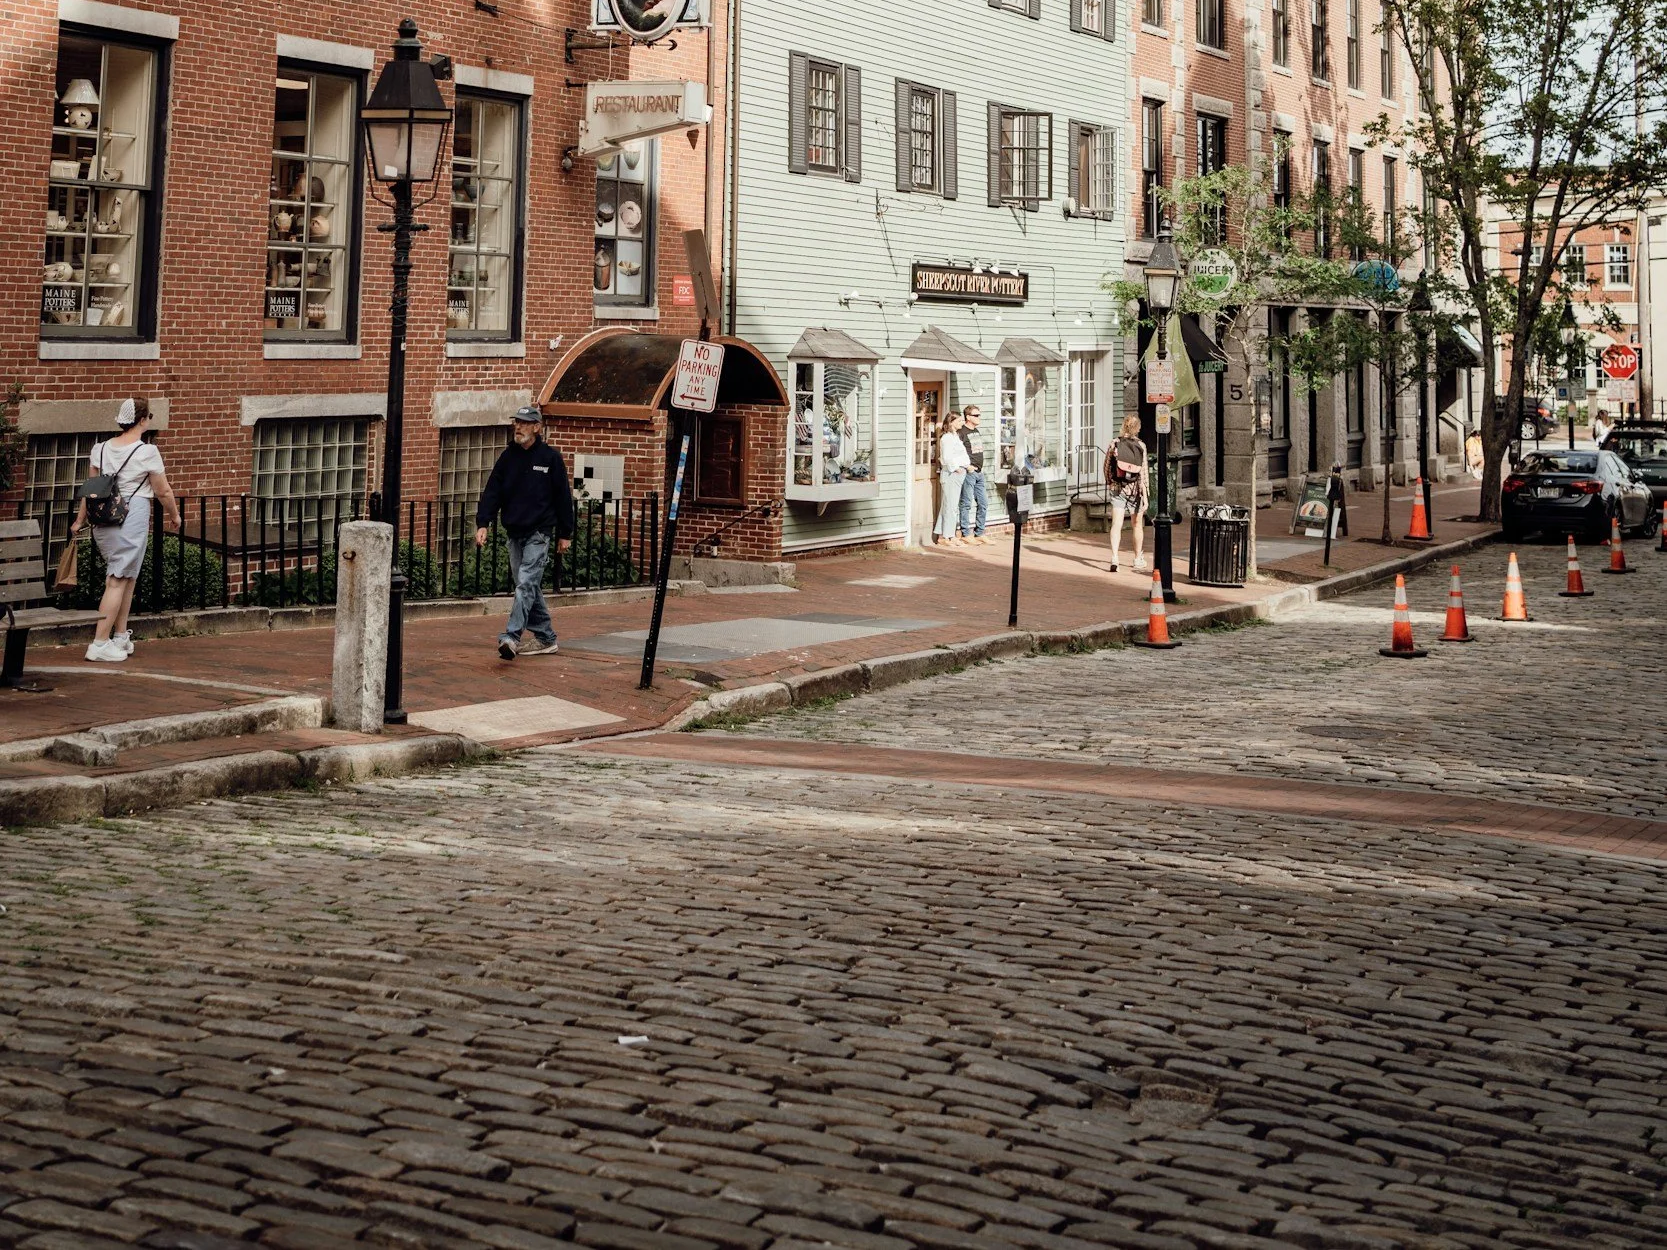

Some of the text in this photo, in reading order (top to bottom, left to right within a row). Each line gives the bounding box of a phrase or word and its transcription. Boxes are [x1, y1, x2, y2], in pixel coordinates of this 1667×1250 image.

[593, 95, 682, 113] RESTAURANT
[917, 270, 1025, 296] SHEEPSCOT RIVER POTTERY
[45, 289, 76, 298] MAINE
[44, 298, 76, 307] POTTERS
[269, 304, 296, 312] POTTERS
[694, 347, 710, 360] NO
[1603, 354, 1636, 368] STOP
[681, 359, 718, 377] PARKING
[689, 375, 706, 385] ANY
[686, 384, 706, 396] TIME
[1230, 384, 1243, 400] 5
